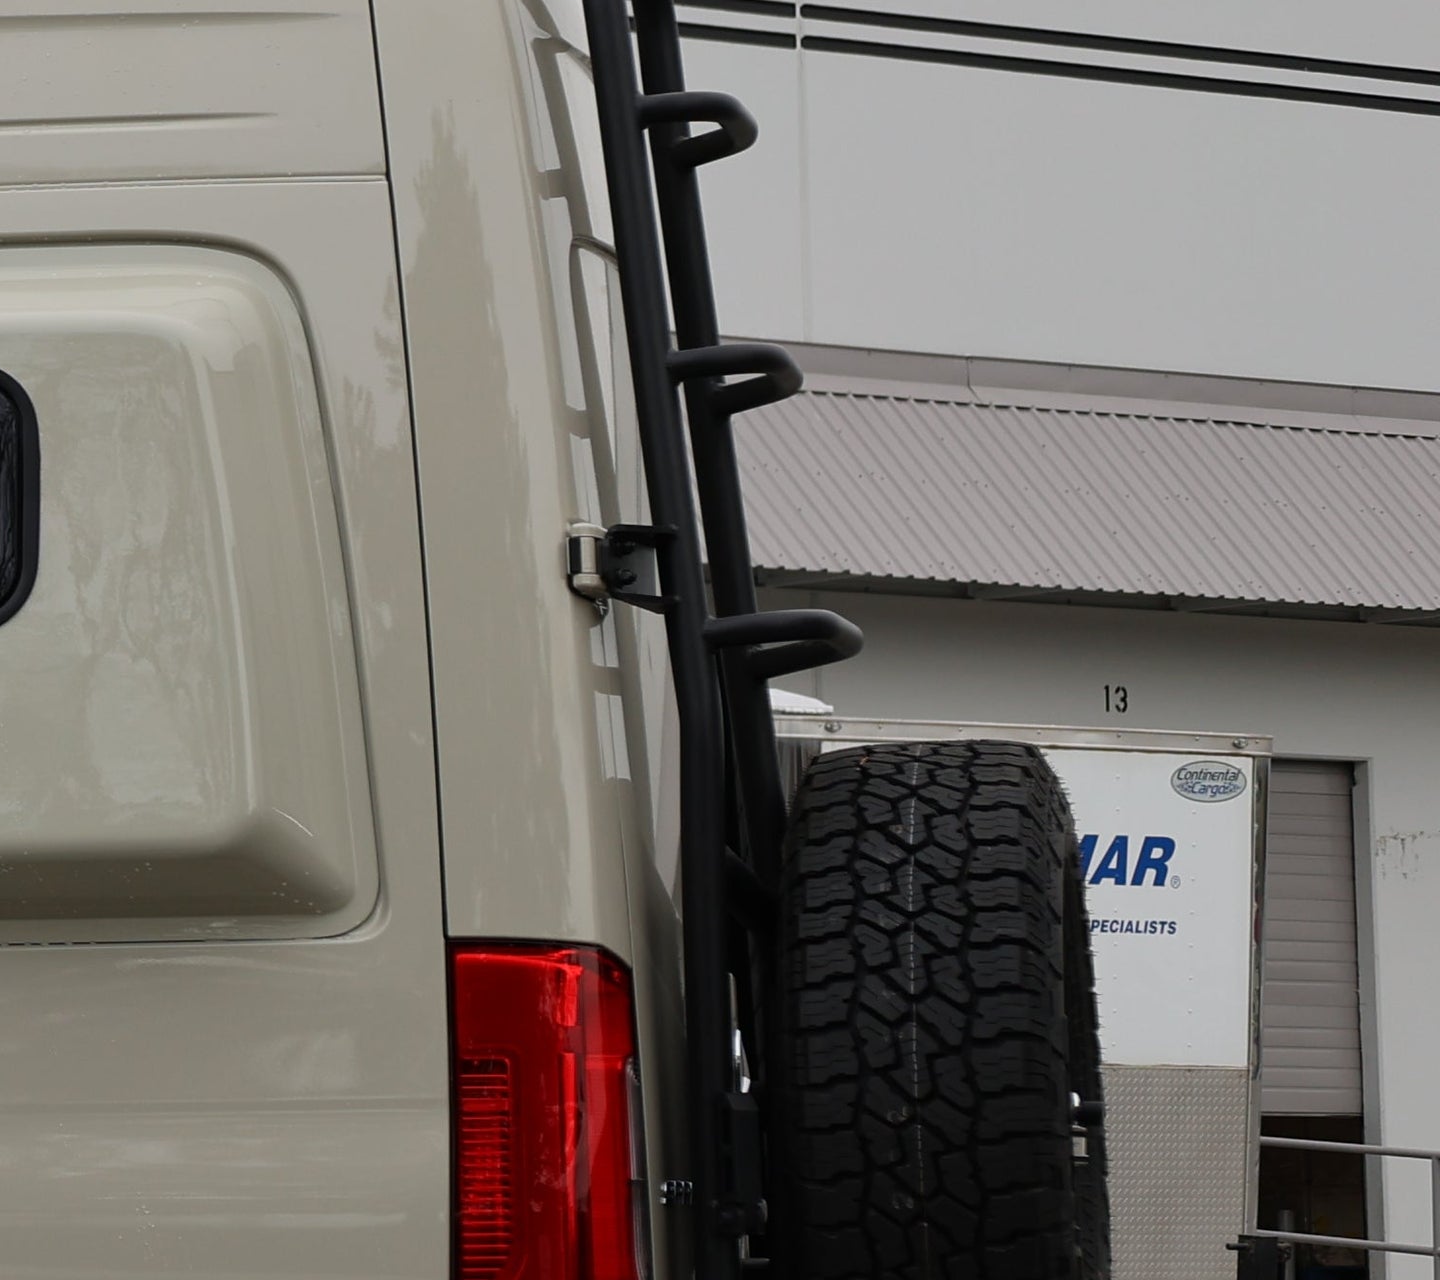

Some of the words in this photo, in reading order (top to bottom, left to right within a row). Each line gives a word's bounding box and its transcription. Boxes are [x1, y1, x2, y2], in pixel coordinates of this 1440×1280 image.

[1104, 684, 1128, 713] 13
[1176, 767, 1241, 782] Continental
[1191, 781, 1226, 797] Cargo
[1089, 919, 1178, 934] PECIALISTS
